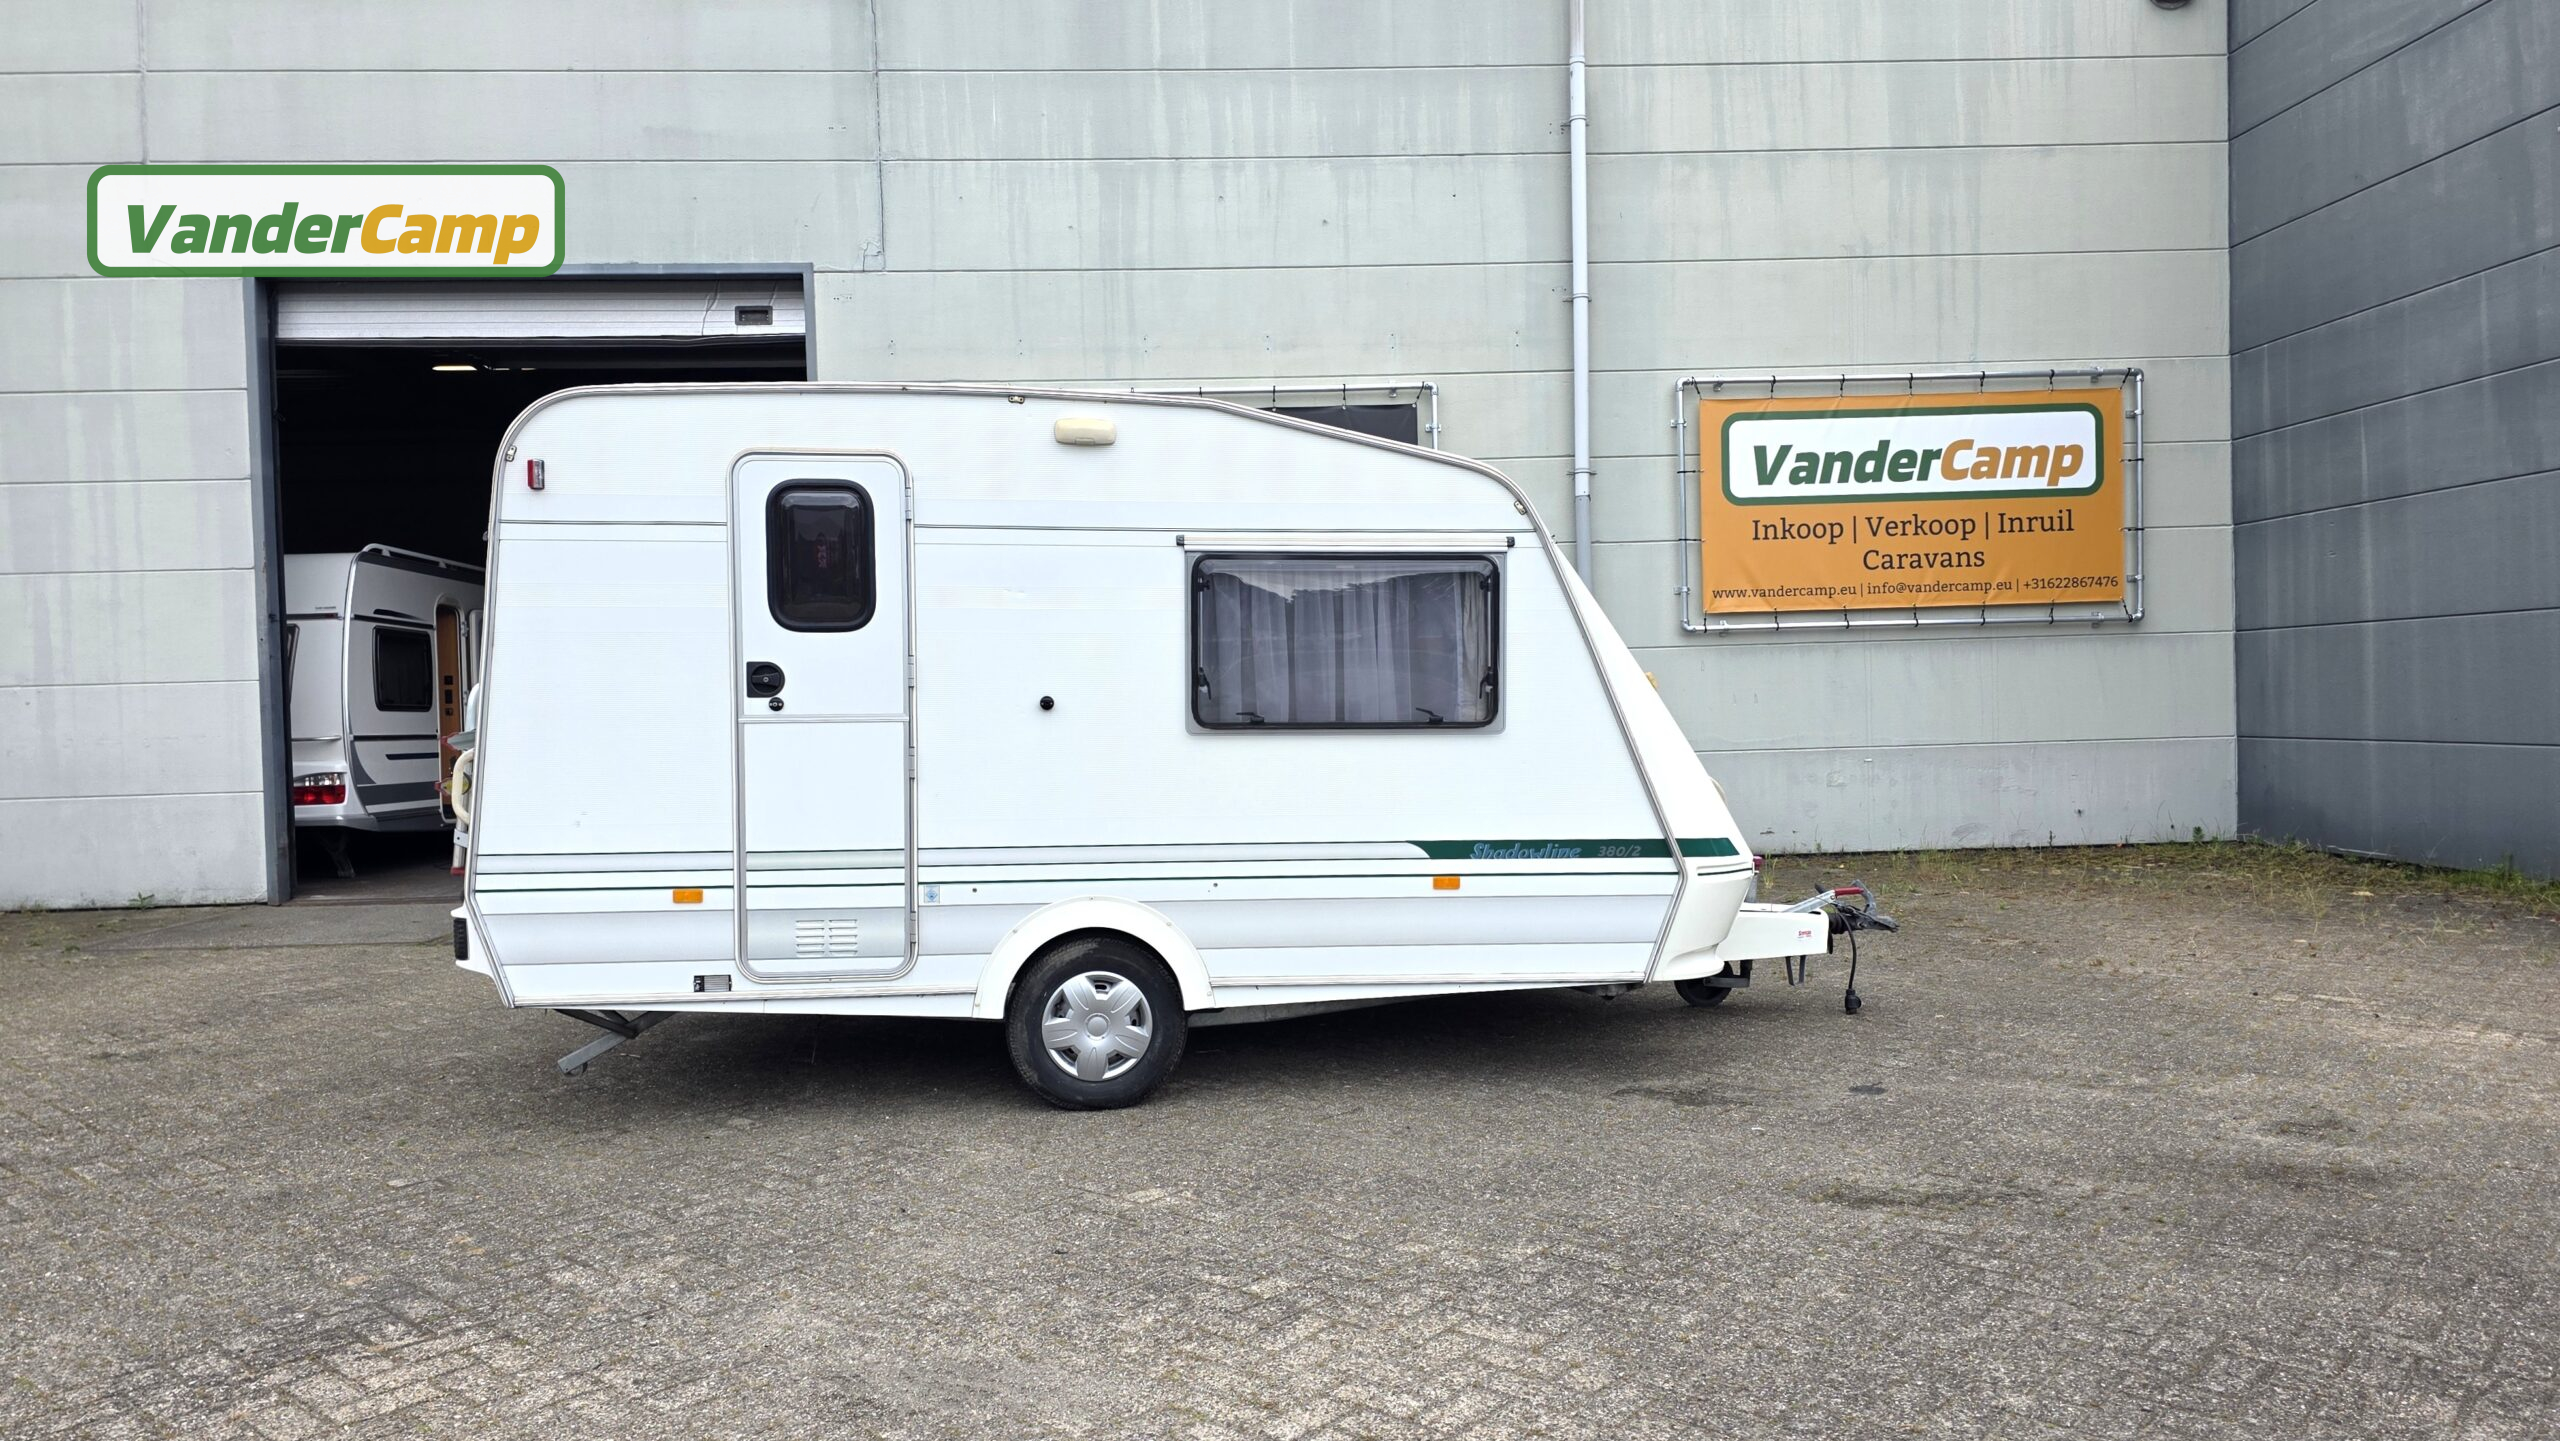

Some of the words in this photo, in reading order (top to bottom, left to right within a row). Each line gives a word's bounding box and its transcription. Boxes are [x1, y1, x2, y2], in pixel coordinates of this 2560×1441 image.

[1753, 438, 2085, 487] VanderCamp
[1752, 517, 1844, 544] Inkoop
[1865, 513, 1976, 540] Verkoop
[1998, 509, 2075, 533] Inruil
[1863, 550, 1985, 570] Caravans
[1712, 585, 1857, 599] www.vandercamp.eu
[1867, 581, 2012, 595] info@vandercamp.eu
[2023, 576, 2119, 590] +31622867476
[1470, 843, 1582, 859] Shadowline
[1597, 845, 1642, 857] 380/2
